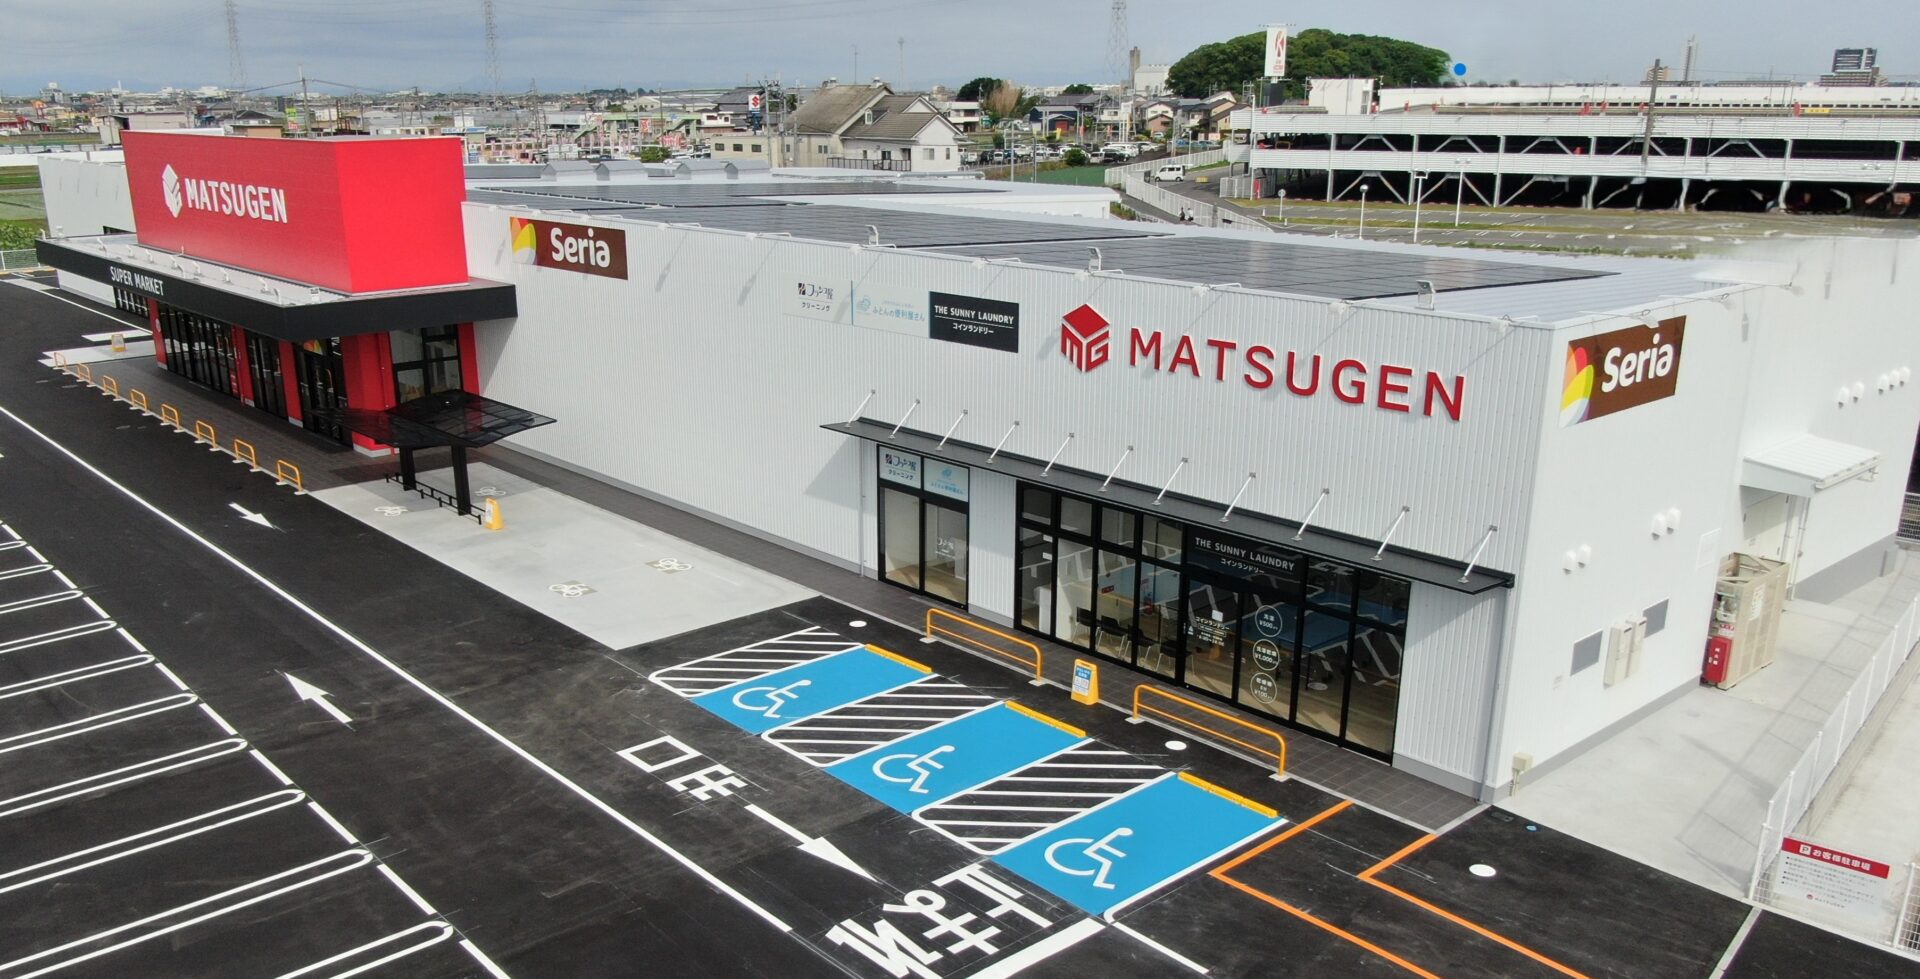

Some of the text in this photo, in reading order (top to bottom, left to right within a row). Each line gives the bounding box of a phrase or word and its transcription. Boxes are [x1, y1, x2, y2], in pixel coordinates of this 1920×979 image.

[185, 178, 288, 224] MATSUGEN
[550, 227, 610, 268] Seria
[110, 266, 164, 296] SUPER MARKET
[802, 302, 830, 312] クリーニング
[934, 304, 1014, 325] THE SUNNY LAUNDRY
[952, 322, 994, 335] コインランドリー
[1130, 327, 1465, 422] MATSUGEN
[1602, 333, 1674, 392] Seria
[1194, 537, 1295, 571] THE SUNNY LAUNDRY
[1220, 558, 1265, 574] コインランドリー
[825, 863, 1053, 979] 止まれ
